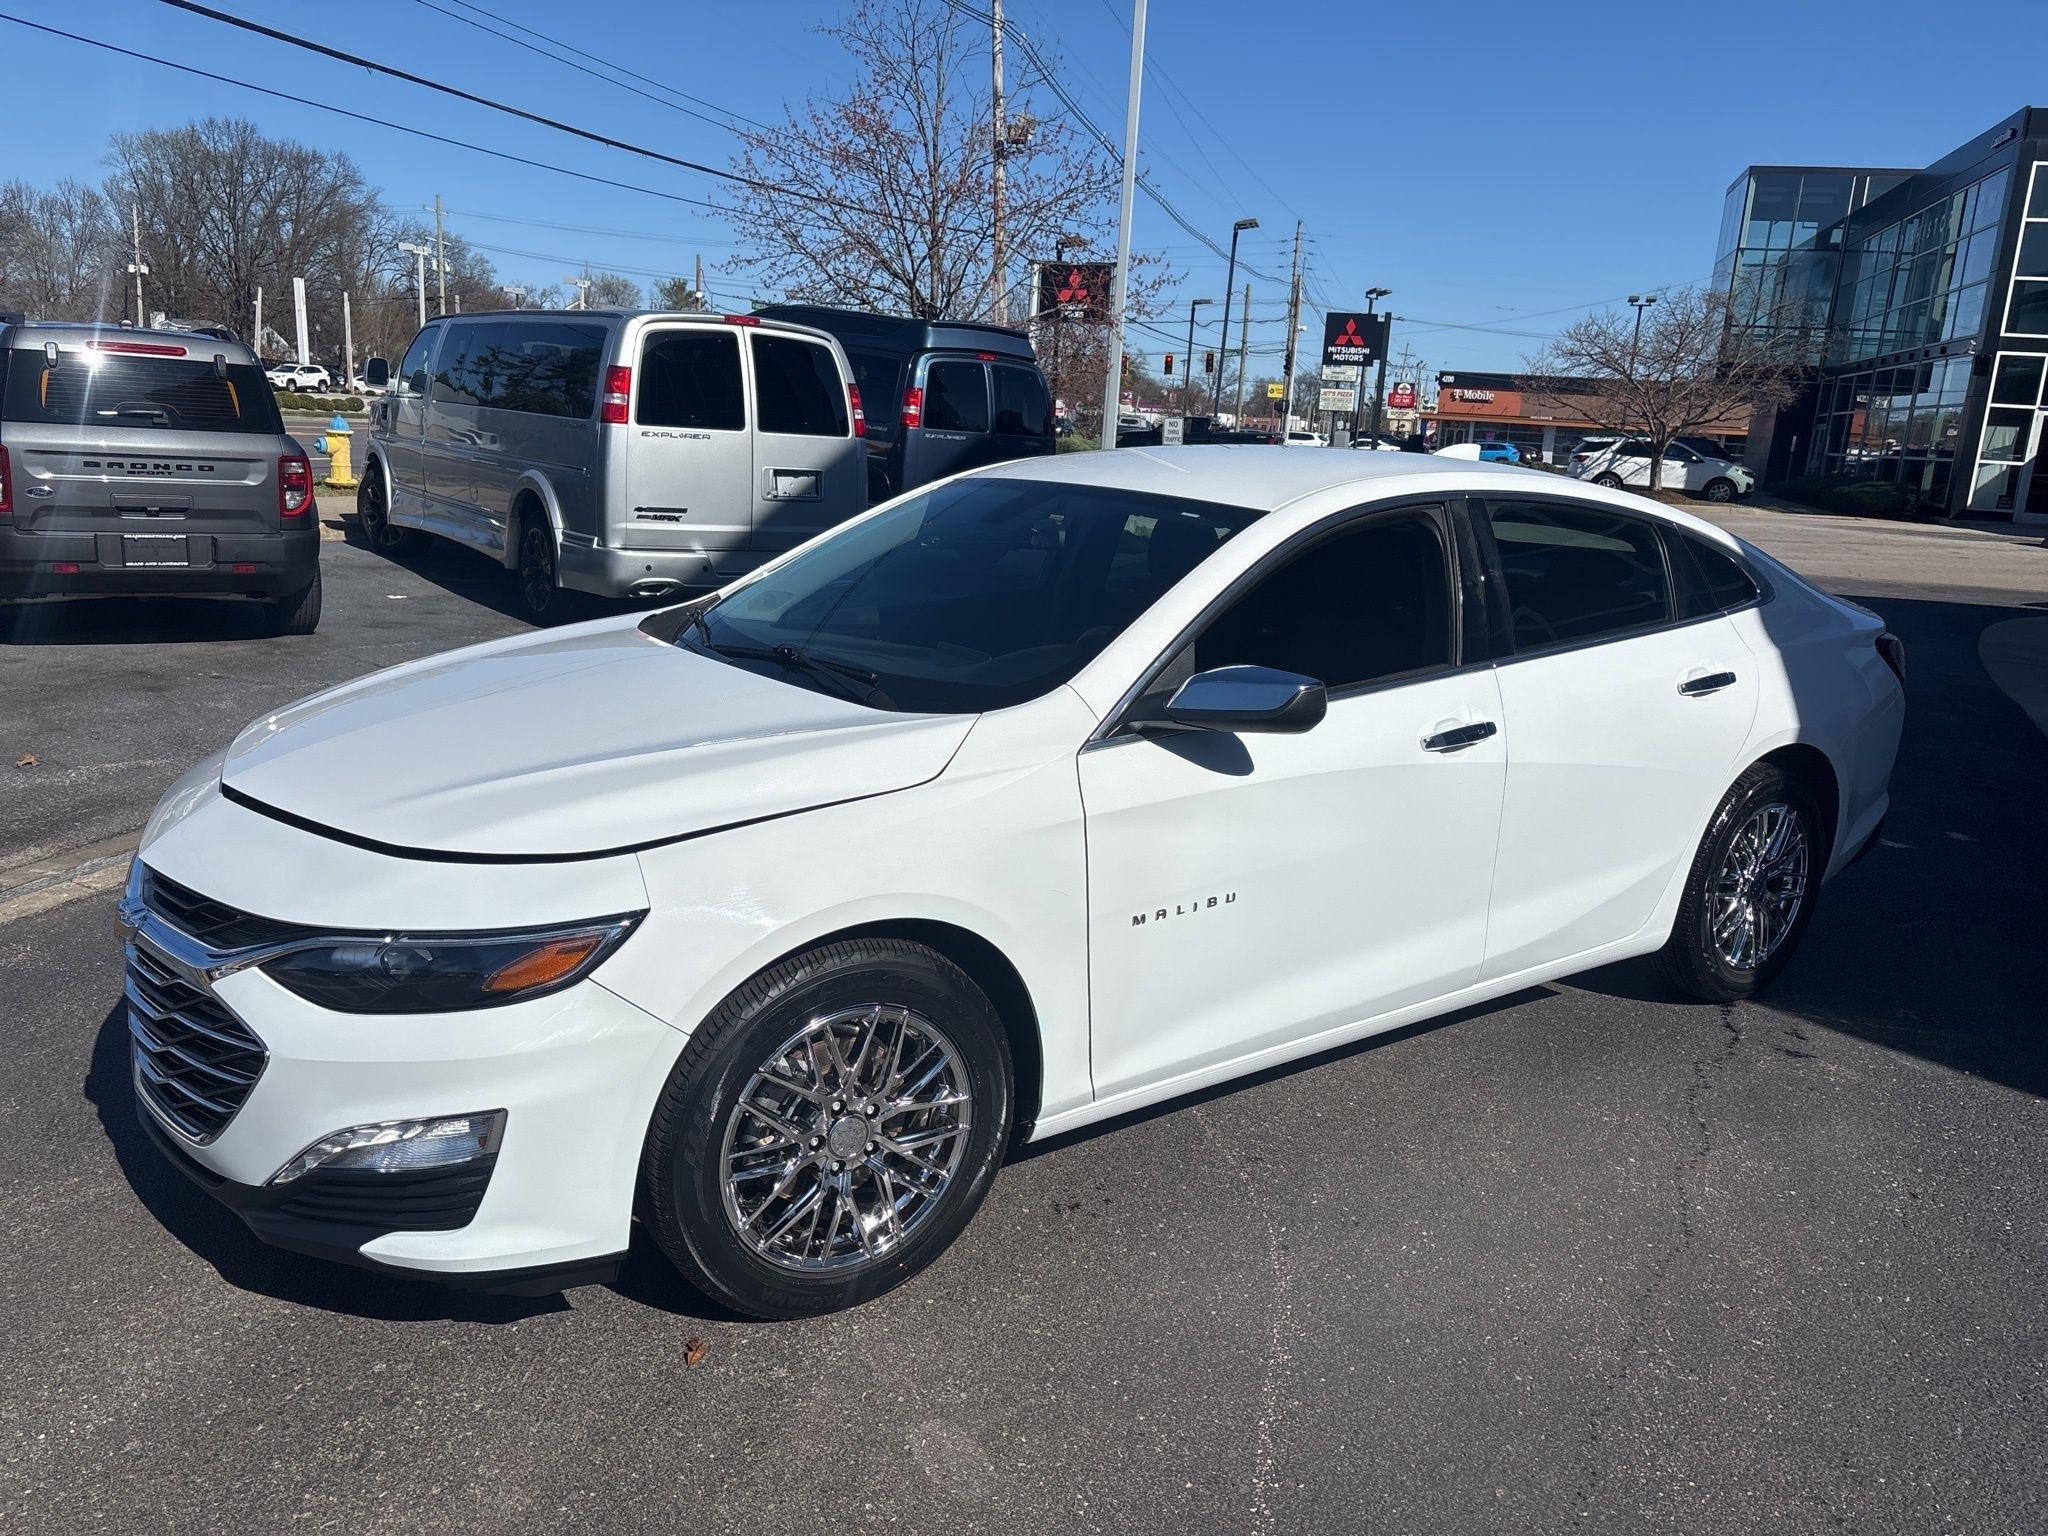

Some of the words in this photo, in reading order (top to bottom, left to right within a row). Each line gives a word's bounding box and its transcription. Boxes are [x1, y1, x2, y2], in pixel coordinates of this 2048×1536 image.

[1327, 346, 1370, 355] MITSUBISHI
[1332, 354, 1364, 362] MOTORS
[1453, 388, 1495, 401] T-Mobile
[1168, 420, 1179, 428] NO
[83, 460, 215, 472] BRONCO
[1131, 892, 1237, 927] MALIBU
